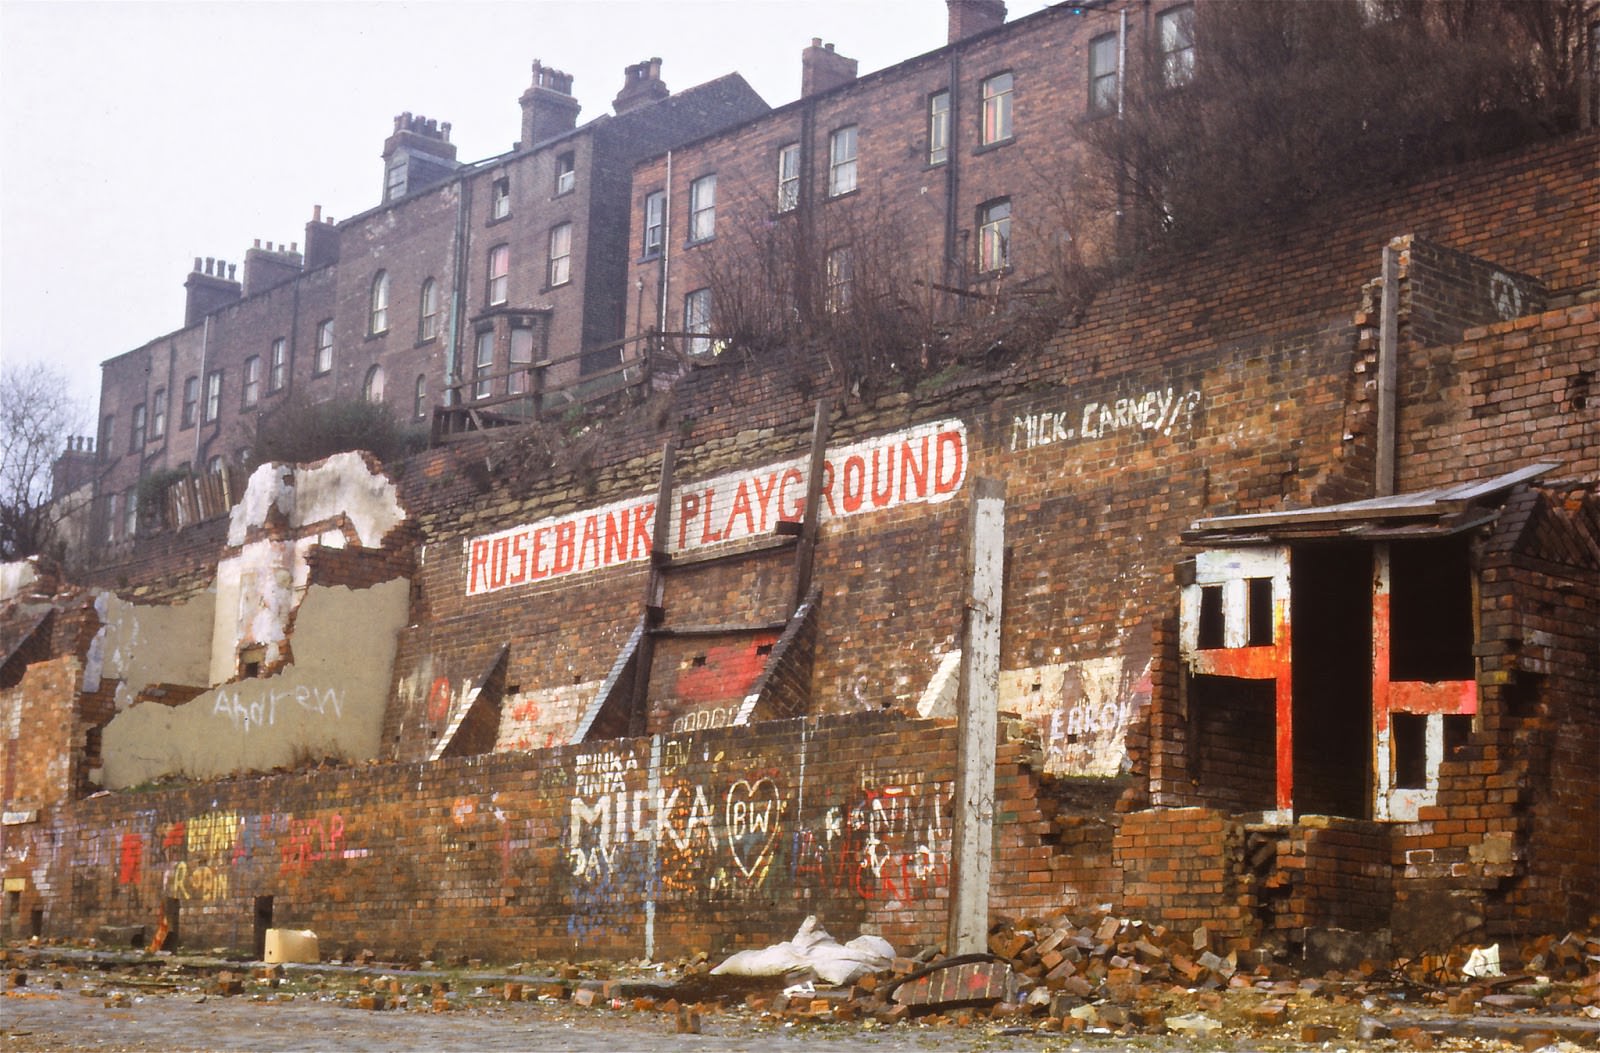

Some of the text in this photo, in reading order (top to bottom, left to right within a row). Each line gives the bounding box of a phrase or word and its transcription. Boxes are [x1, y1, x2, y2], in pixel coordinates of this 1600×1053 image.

[469, 431, 963, 593] ROSEBANK PLAYGROUND
[734, 800, 771, 840] BW
